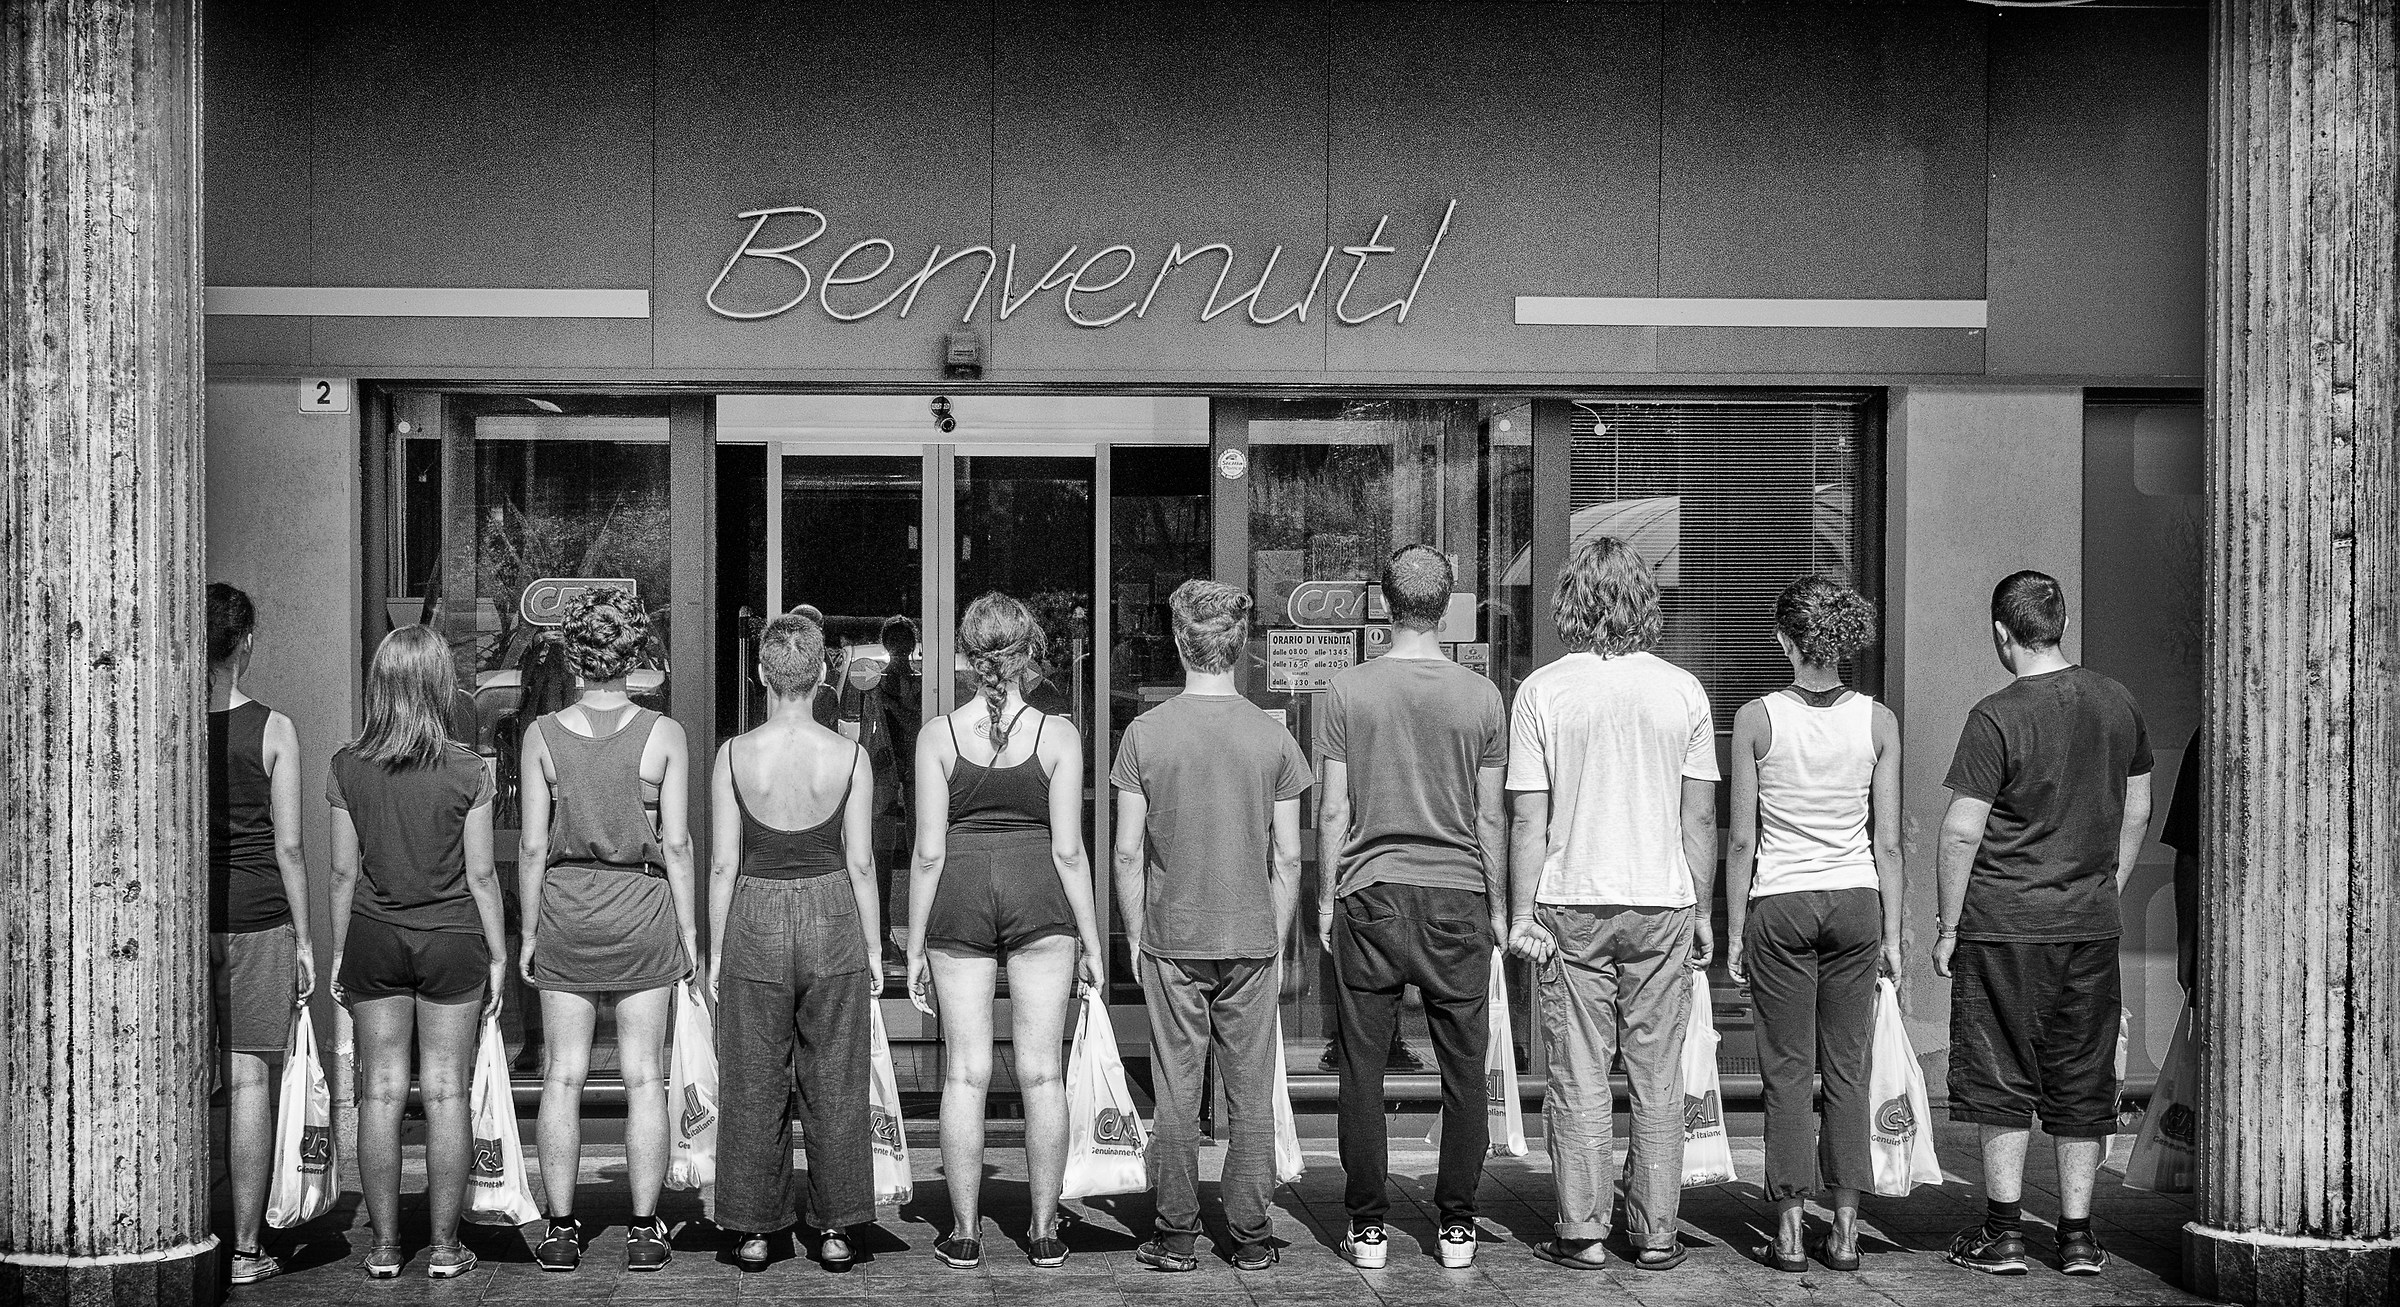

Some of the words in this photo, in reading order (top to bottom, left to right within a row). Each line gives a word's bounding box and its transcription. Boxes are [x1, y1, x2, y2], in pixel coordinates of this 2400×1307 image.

[316, 380, 331, 405] 2
[1272, 635, 1303, 645] ORARIO
[1306, 635, 1315, 645] DI
[1317, 635, 1351, 645] VENDITA
[1272, 648, 1287, 656] dalle
[1314, 648, 1327, 656] alle
[1328, 648, 1348, 656] 1345
[1272, 660, 1287, 668] dalle
[1314, 660, 1327, 668] alle
[1328, 660, 1349, 669] 2030
